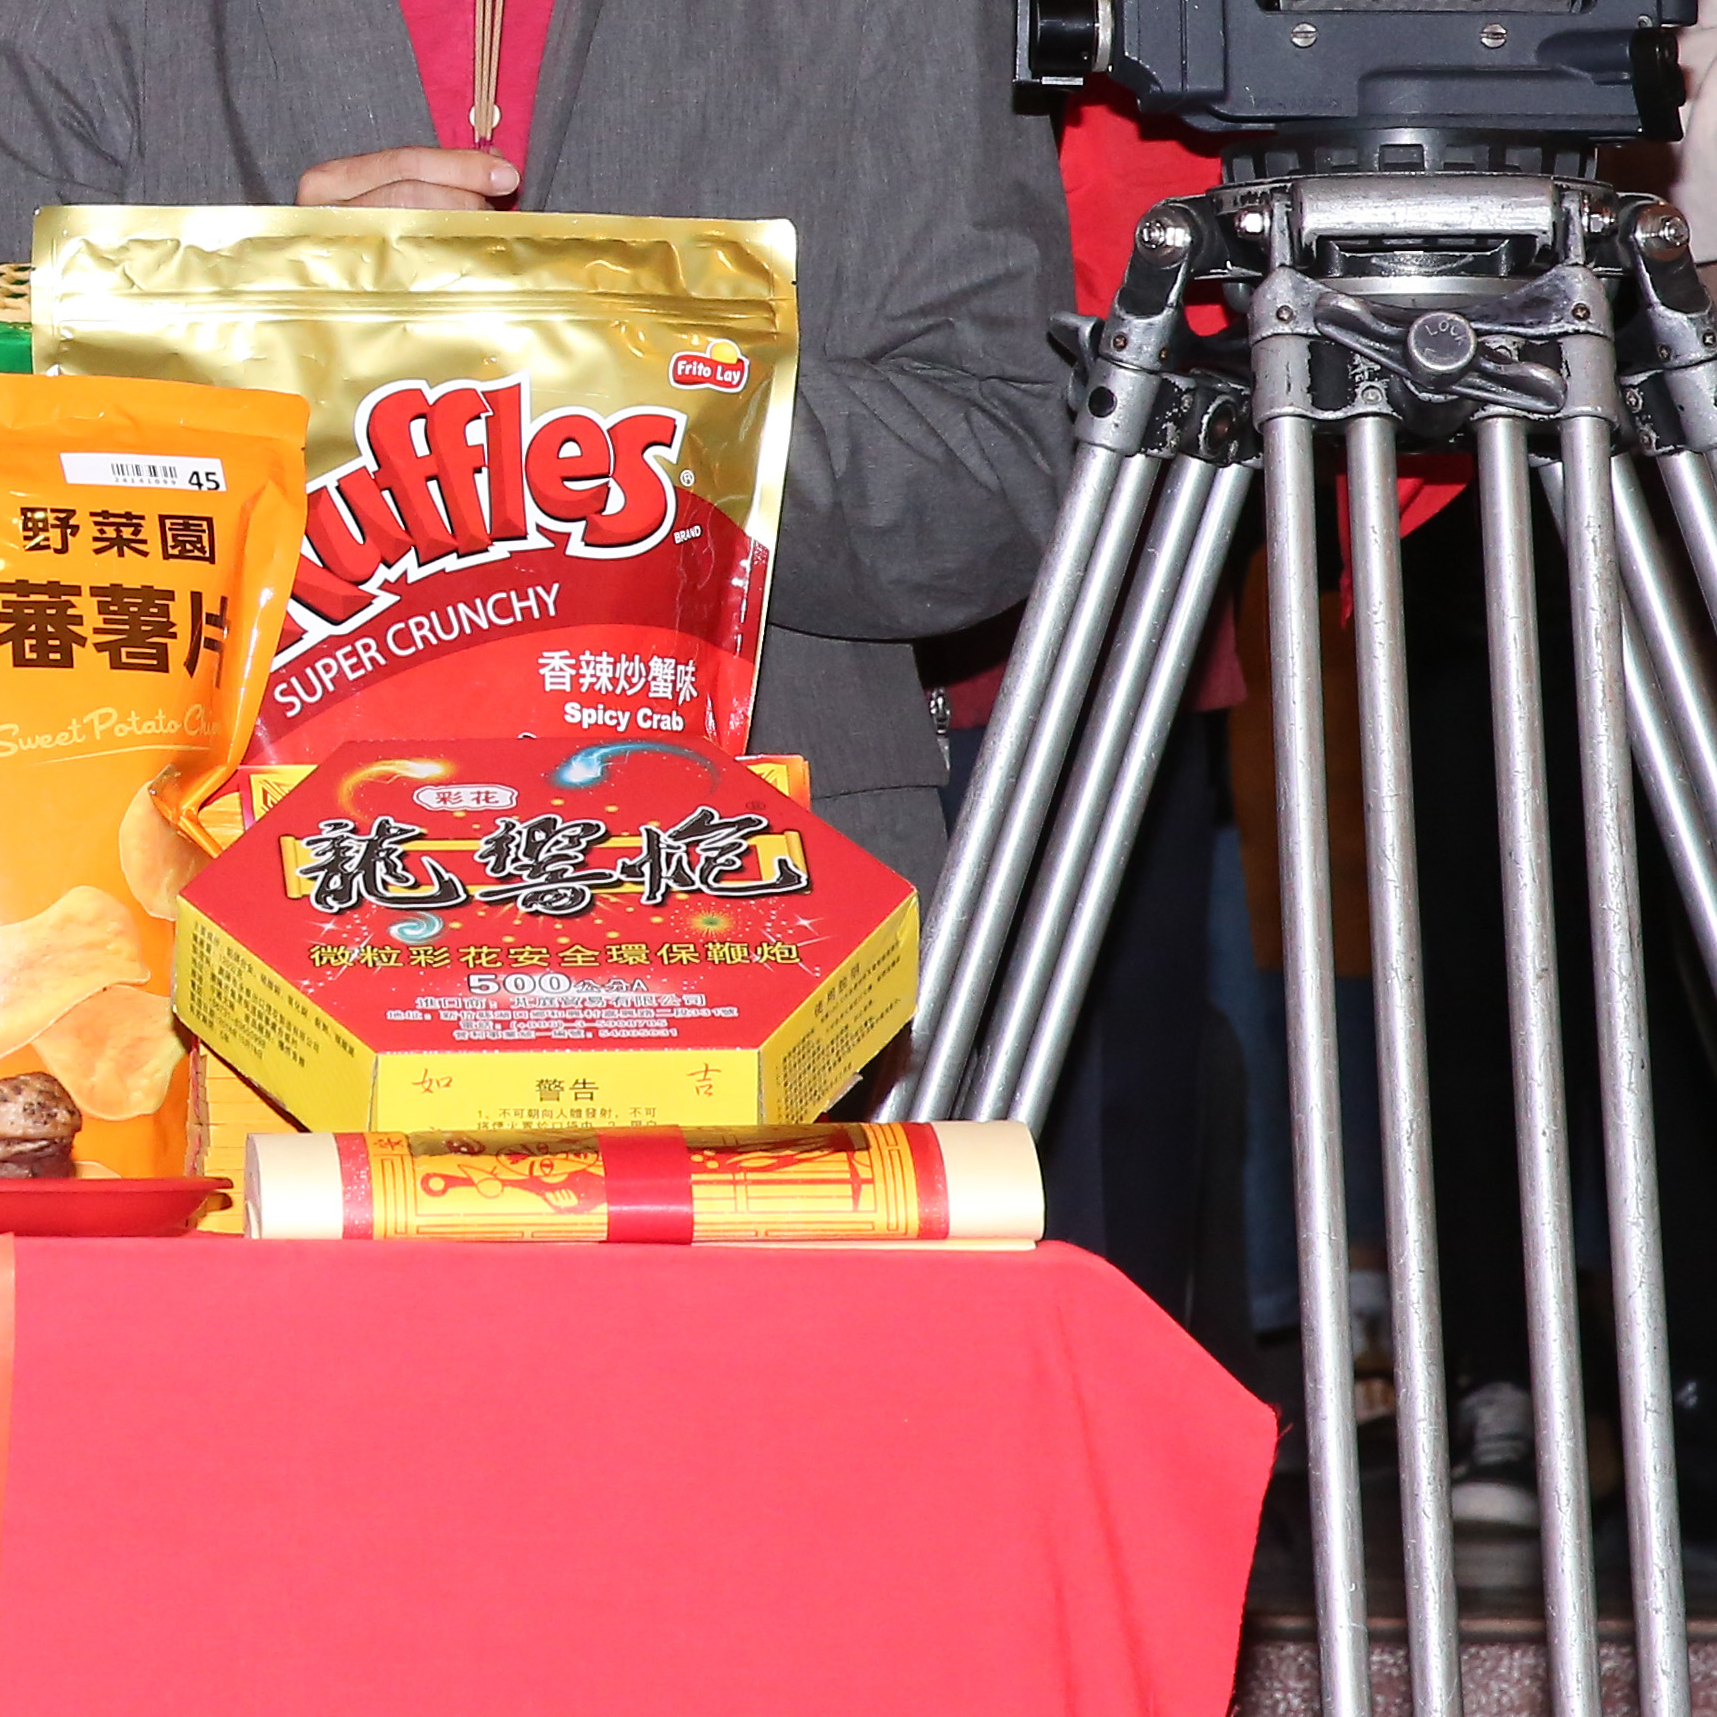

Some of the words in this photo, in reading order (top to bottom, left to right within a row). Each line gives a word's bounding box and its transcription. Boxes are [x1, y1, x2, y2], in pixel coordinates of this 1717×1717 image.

[1424, 319, 1466, 346] LOCK
[677, 360, 712, 378] Frito
[716, 365, 740, 385] Lay
[188, 470, 221, 491] 45
[18, 505, 216, 565] 野菜園
[273, 636, 385, 718] SUPER
[385, 583, 561, 661] CRUNCHY
[537, 650, 699, 706] 香辣炒蟹味
[83, 707, 181, 740] Potato
[563, 701, 630, 733] Spicy
[636, 705, 685, 733] Crab
[434, 788, 503, 807] 彩花
[309, 942, 802, 970] 微粒彩花安全環保鞭炮
[412, 1067, 454, 1094] 如
[535, 1077, 600, 1102] 警告
[687, 1063, 723, 1097] 吉
